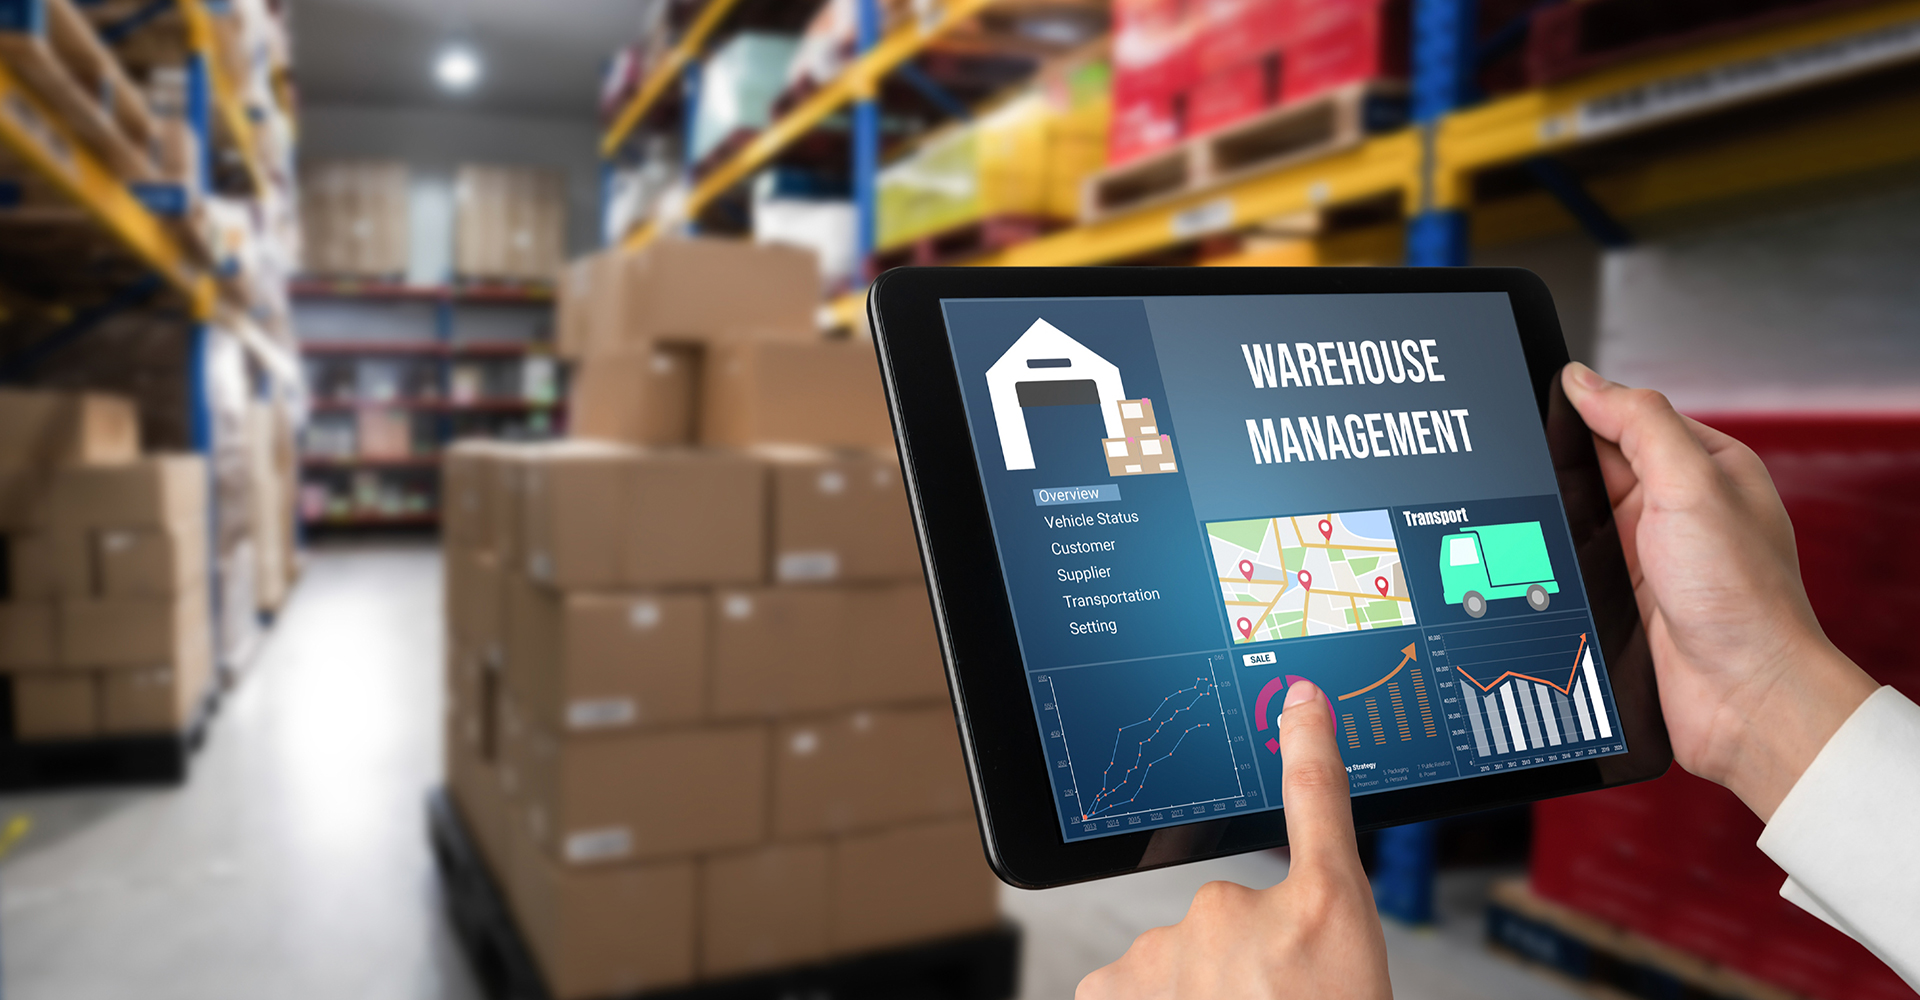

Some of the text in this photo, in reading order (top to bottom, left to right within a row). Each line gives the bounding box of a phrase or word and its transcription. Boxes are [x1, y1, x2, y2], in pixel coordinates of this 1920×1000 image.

[1240, 339, 1446, 389] WAREHOUSE
[1245, 409, 1473, 465] MANAGEMENT
[1038, 487, 1099, 503] Overview
[1043, 512, 1140, 529] Vehicle Status
[1403, 507, 1469, 527] Transport
[1051, 540, 1116, 555] Customer
[1056, 566, 1111, 583] Supplier
[1063, 588, 1161, 608] Transportation
[1069, 619, 1118, 635] Setting
[1250, 654, 1271, 664] SALE
[1352, 762, 1377, 771] Strategy
[1083, 823, 1097, 832] 2013
[1106, 819, 1120, 828] 2014
[1128, 816, 1141, 825] 2015
[1171, 809, 1184, 818] 2017
[1192, 805, 1205, 814] 2018
[1213, 802, 1226, 811] 2019
